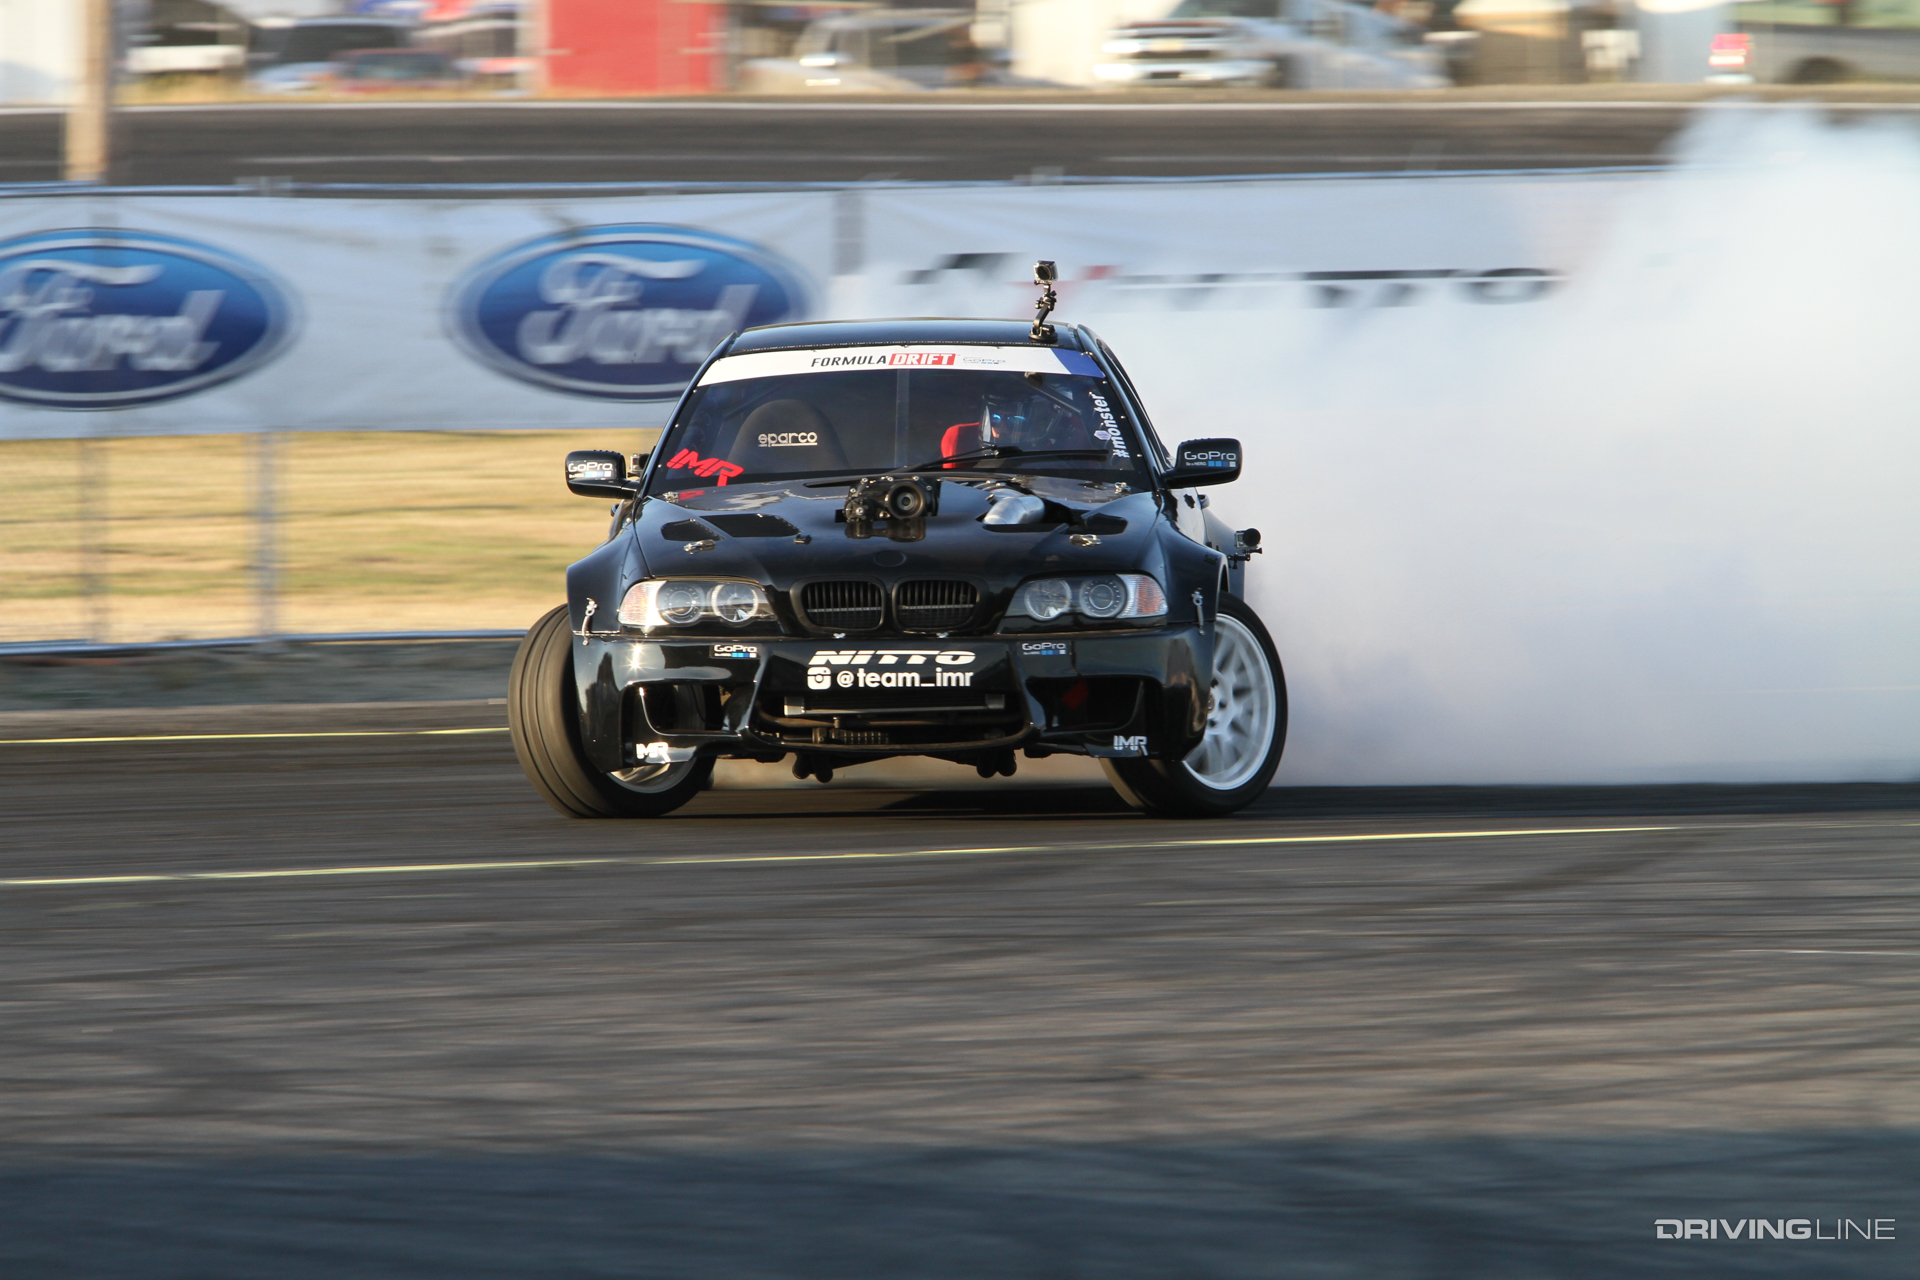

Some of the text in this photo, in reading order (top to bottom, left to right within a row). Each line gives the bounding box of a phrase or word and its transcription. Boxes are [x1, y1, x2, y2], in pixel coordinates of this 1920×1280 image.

[515, 253, 762, 364] Ford
[811, 353, 953, 367] FORMULA DRIFT
[1091, 393, 1130, 458] #monster
[758, 432, 818, 447] sparco
[1184, 450, 1237, 460] GoPro
[568, 461, 613, 472] GoPro
[666, 448, 744, 487] IMR
[714, 644, 758, 652] GoPro
[1022, 642, 1066, 650] GoPro
[808, 650, 976, 665] NITTO
[836, 667, 974, 688] @team_imr
[1113, 735, 1149, 756] IMR
